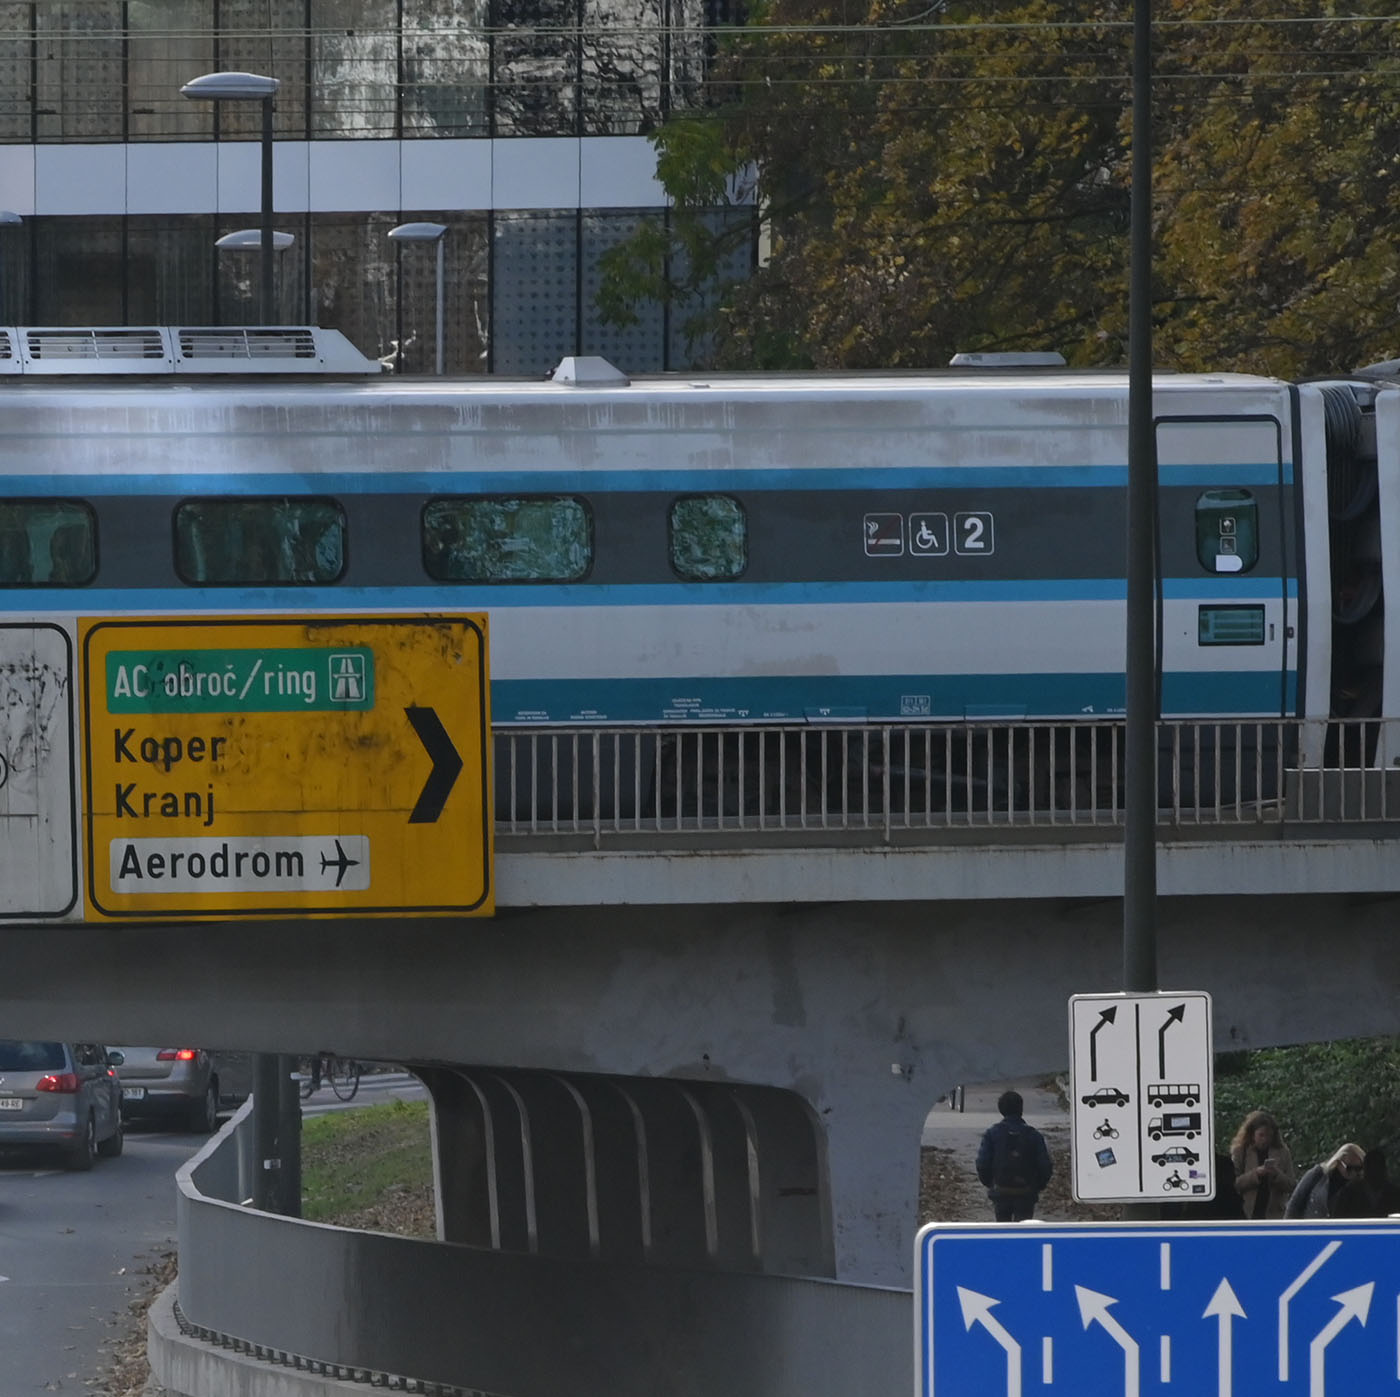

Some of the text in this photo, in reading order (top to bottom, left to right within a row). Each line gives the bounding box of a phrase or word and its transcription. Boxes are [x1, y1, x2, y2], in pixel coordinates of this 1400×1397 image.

[964, 517, 984, 548] 2
[114, 664, 149, 698] AC
[114, 728, 227, 773] Koper
[115, 783, 214, 827] Kranj
[118, 843, 304, 880] Aerodrom
